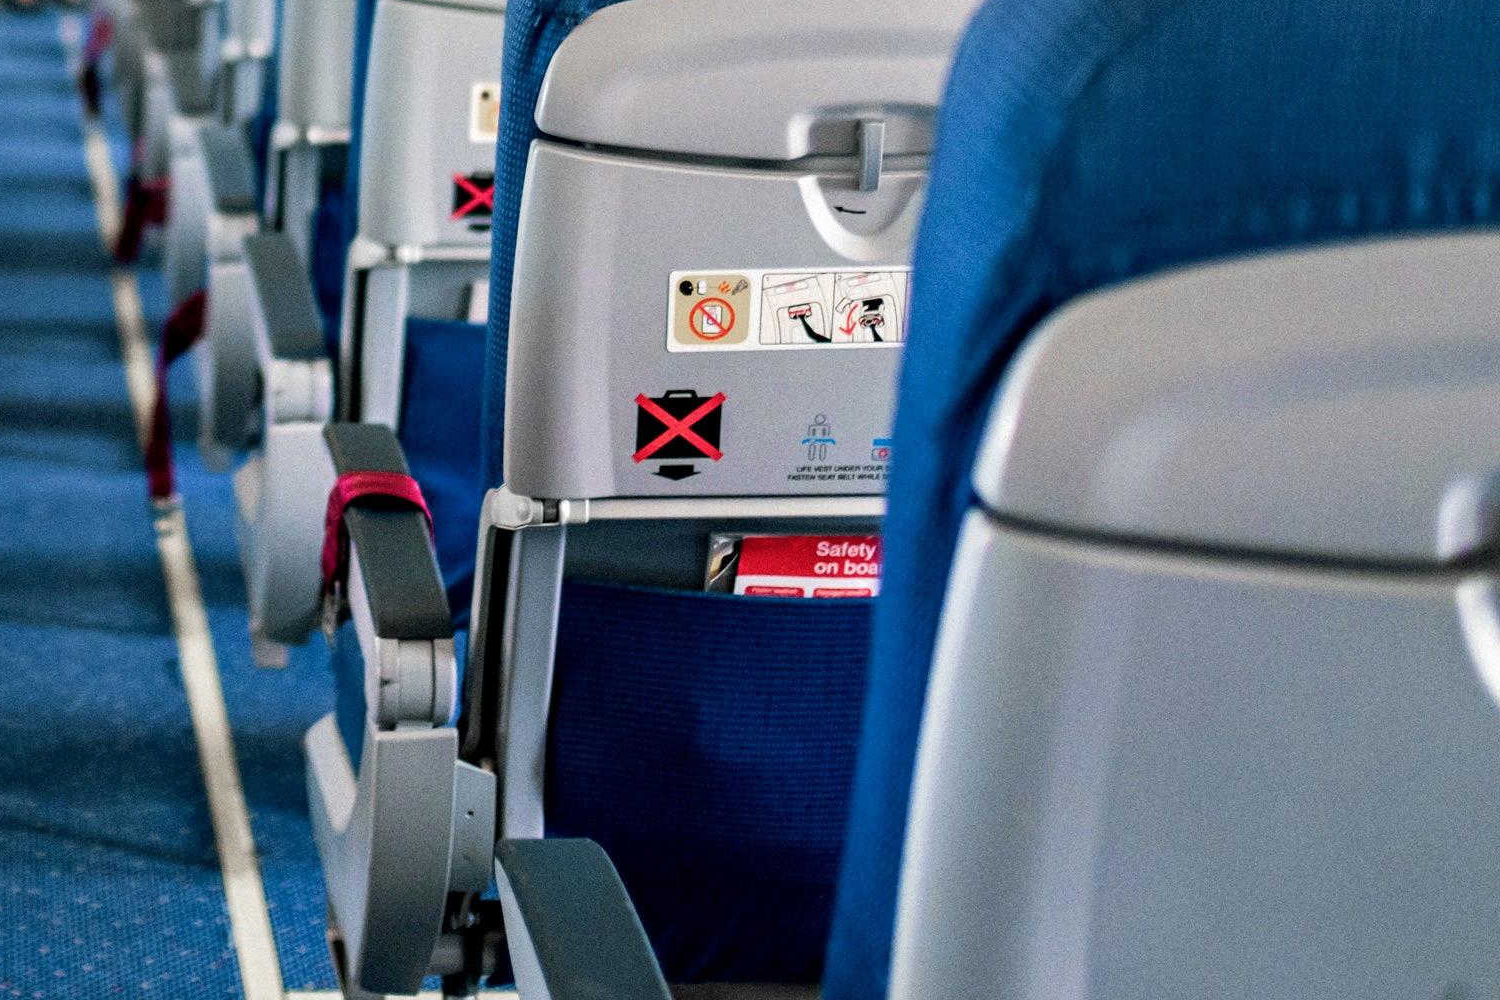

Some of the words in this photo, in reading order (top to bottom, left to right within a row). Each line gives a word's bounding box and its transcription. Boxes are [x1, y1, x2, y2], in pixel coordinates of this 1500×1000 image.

[796, 465, 812, 473] LIFE
[834, 465, 861, 473] UNDER
[816, 541, 877, 561] Safety
[813, 561, 839, 575] on
[843, 559, 881, 575] boa
